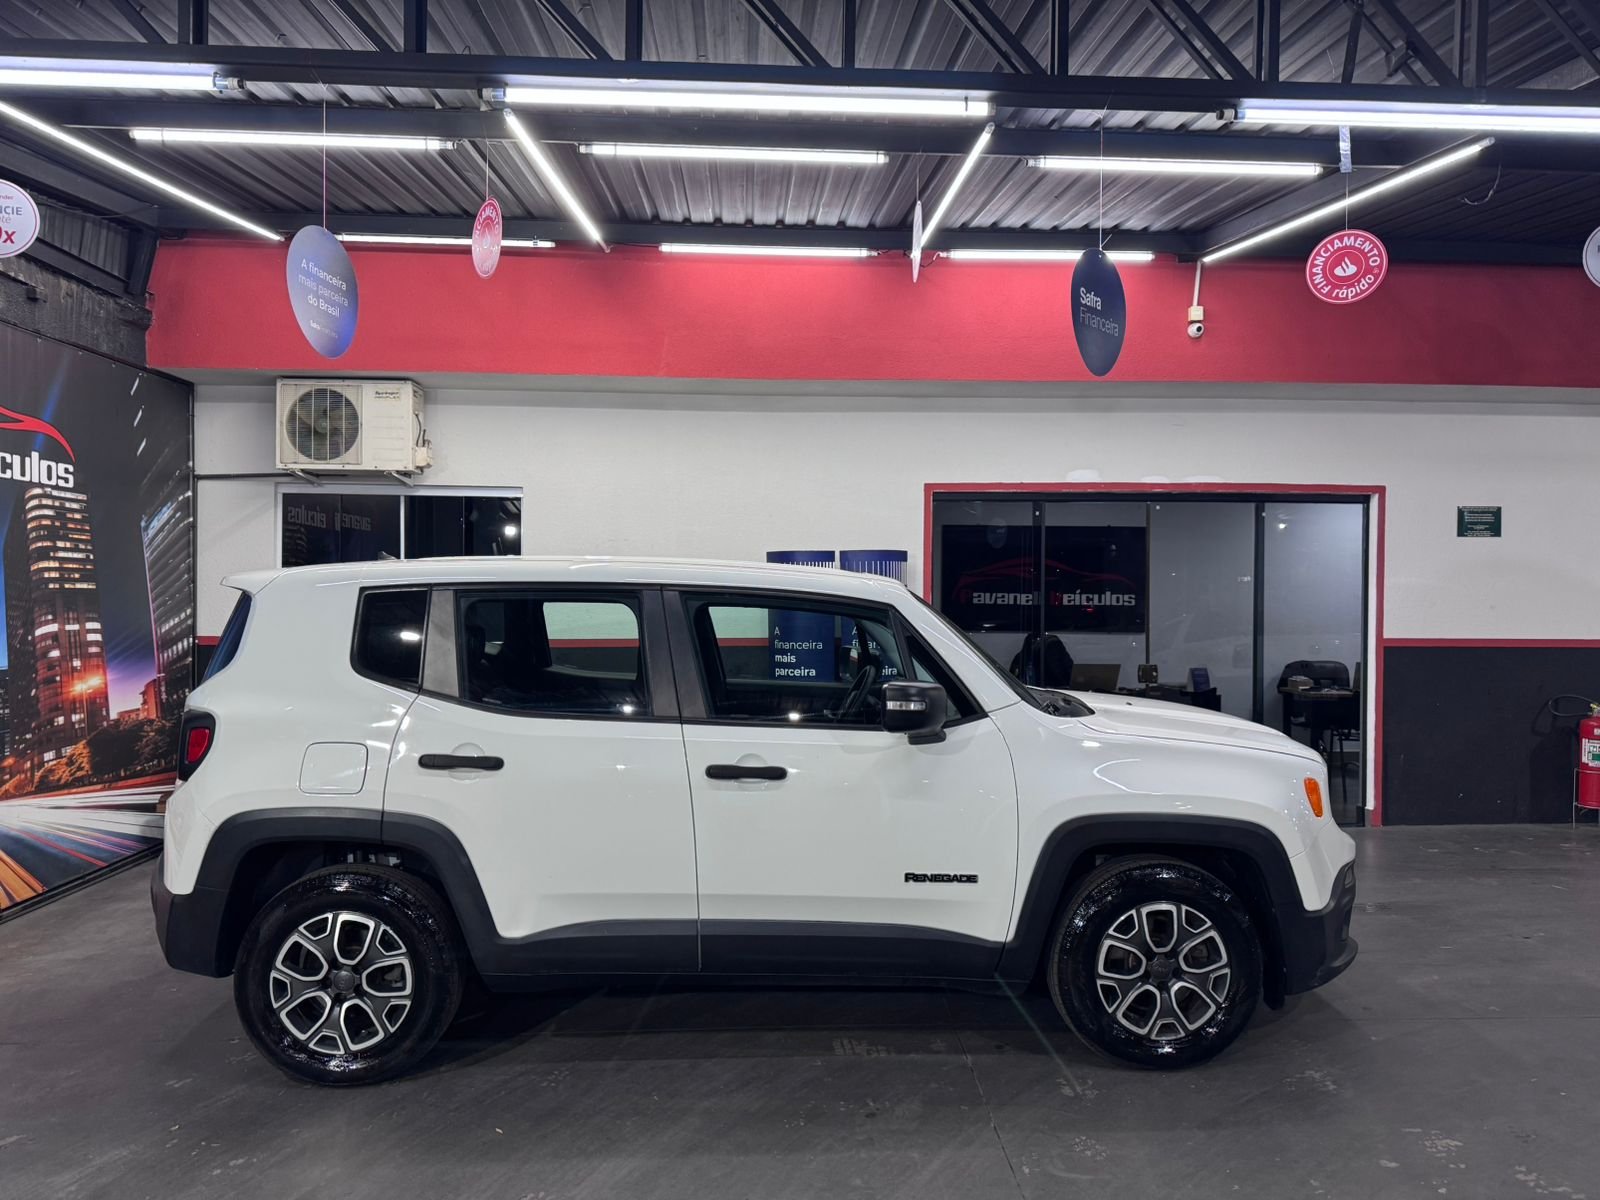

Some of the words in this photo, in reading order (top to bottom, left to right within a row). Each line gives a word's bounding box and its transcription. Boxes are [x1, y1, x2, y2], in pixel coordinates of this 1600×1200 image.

[301, 258, 307, 270] A
[309, 261, 347, 291] financeira
[1312, 235, 1380, 294] FINANCIAMENTO
[298, 274, 317, 291] mais
[318, 284, 349, 307] parceira
[1080, 287, 1102, 310] Safra
[1332, 274, 1375, 300] rápido
[307, 294, 318, 306] do
[319, 298, 340, 317] Brasil
[1080, 306, 1119, 337] Financeira
[0, 451, 74, 488] culos
[774, 626, 781, 635] A
[774, 639, 823, 650] financeira
[775, 653, 796, 663] mais
[775, 665, 816, 677] parceira
[904, 872, 979, 884] RENEGADE
